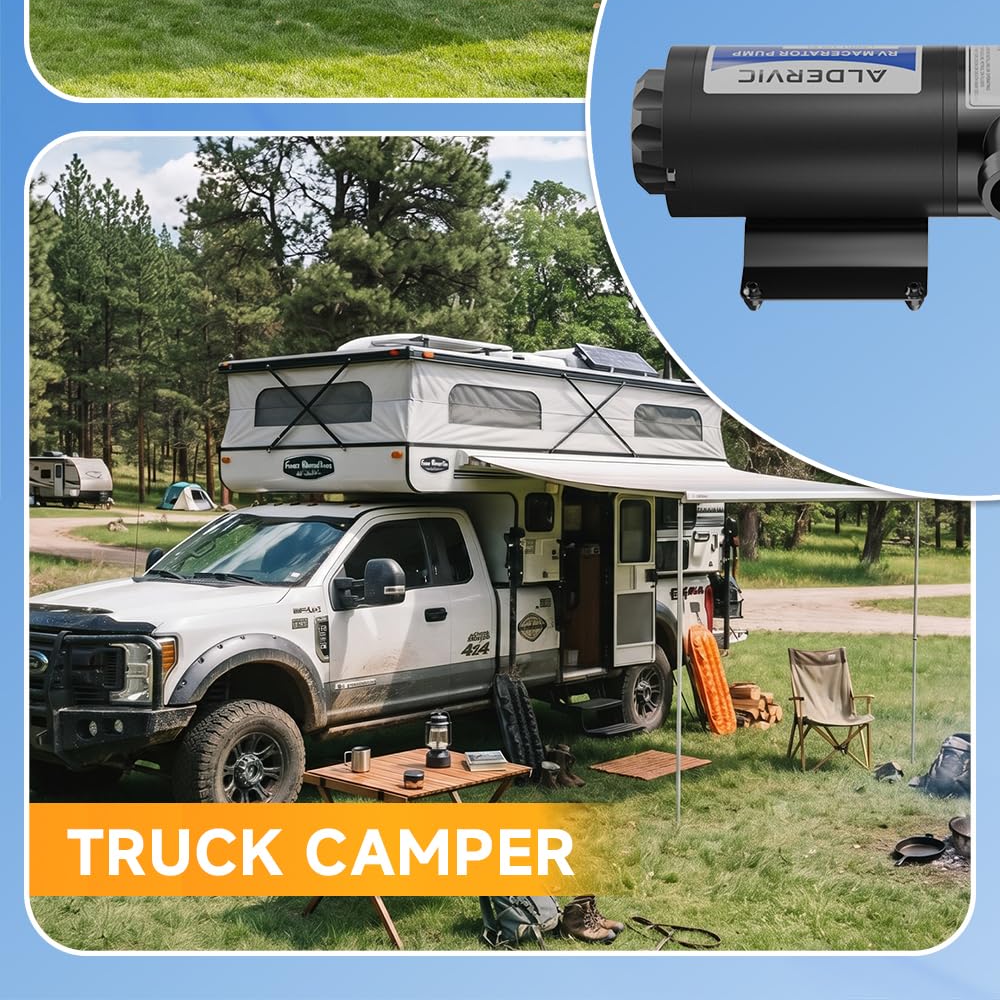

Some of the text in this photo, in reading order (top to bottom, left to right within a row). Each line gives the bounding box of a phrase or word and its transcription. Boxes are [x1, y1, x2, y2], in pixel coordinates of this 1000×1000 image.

[731, 49, 899, 57] RV MACERATOR PUMP
[737, 69, 888, 83] ALDERVIC
